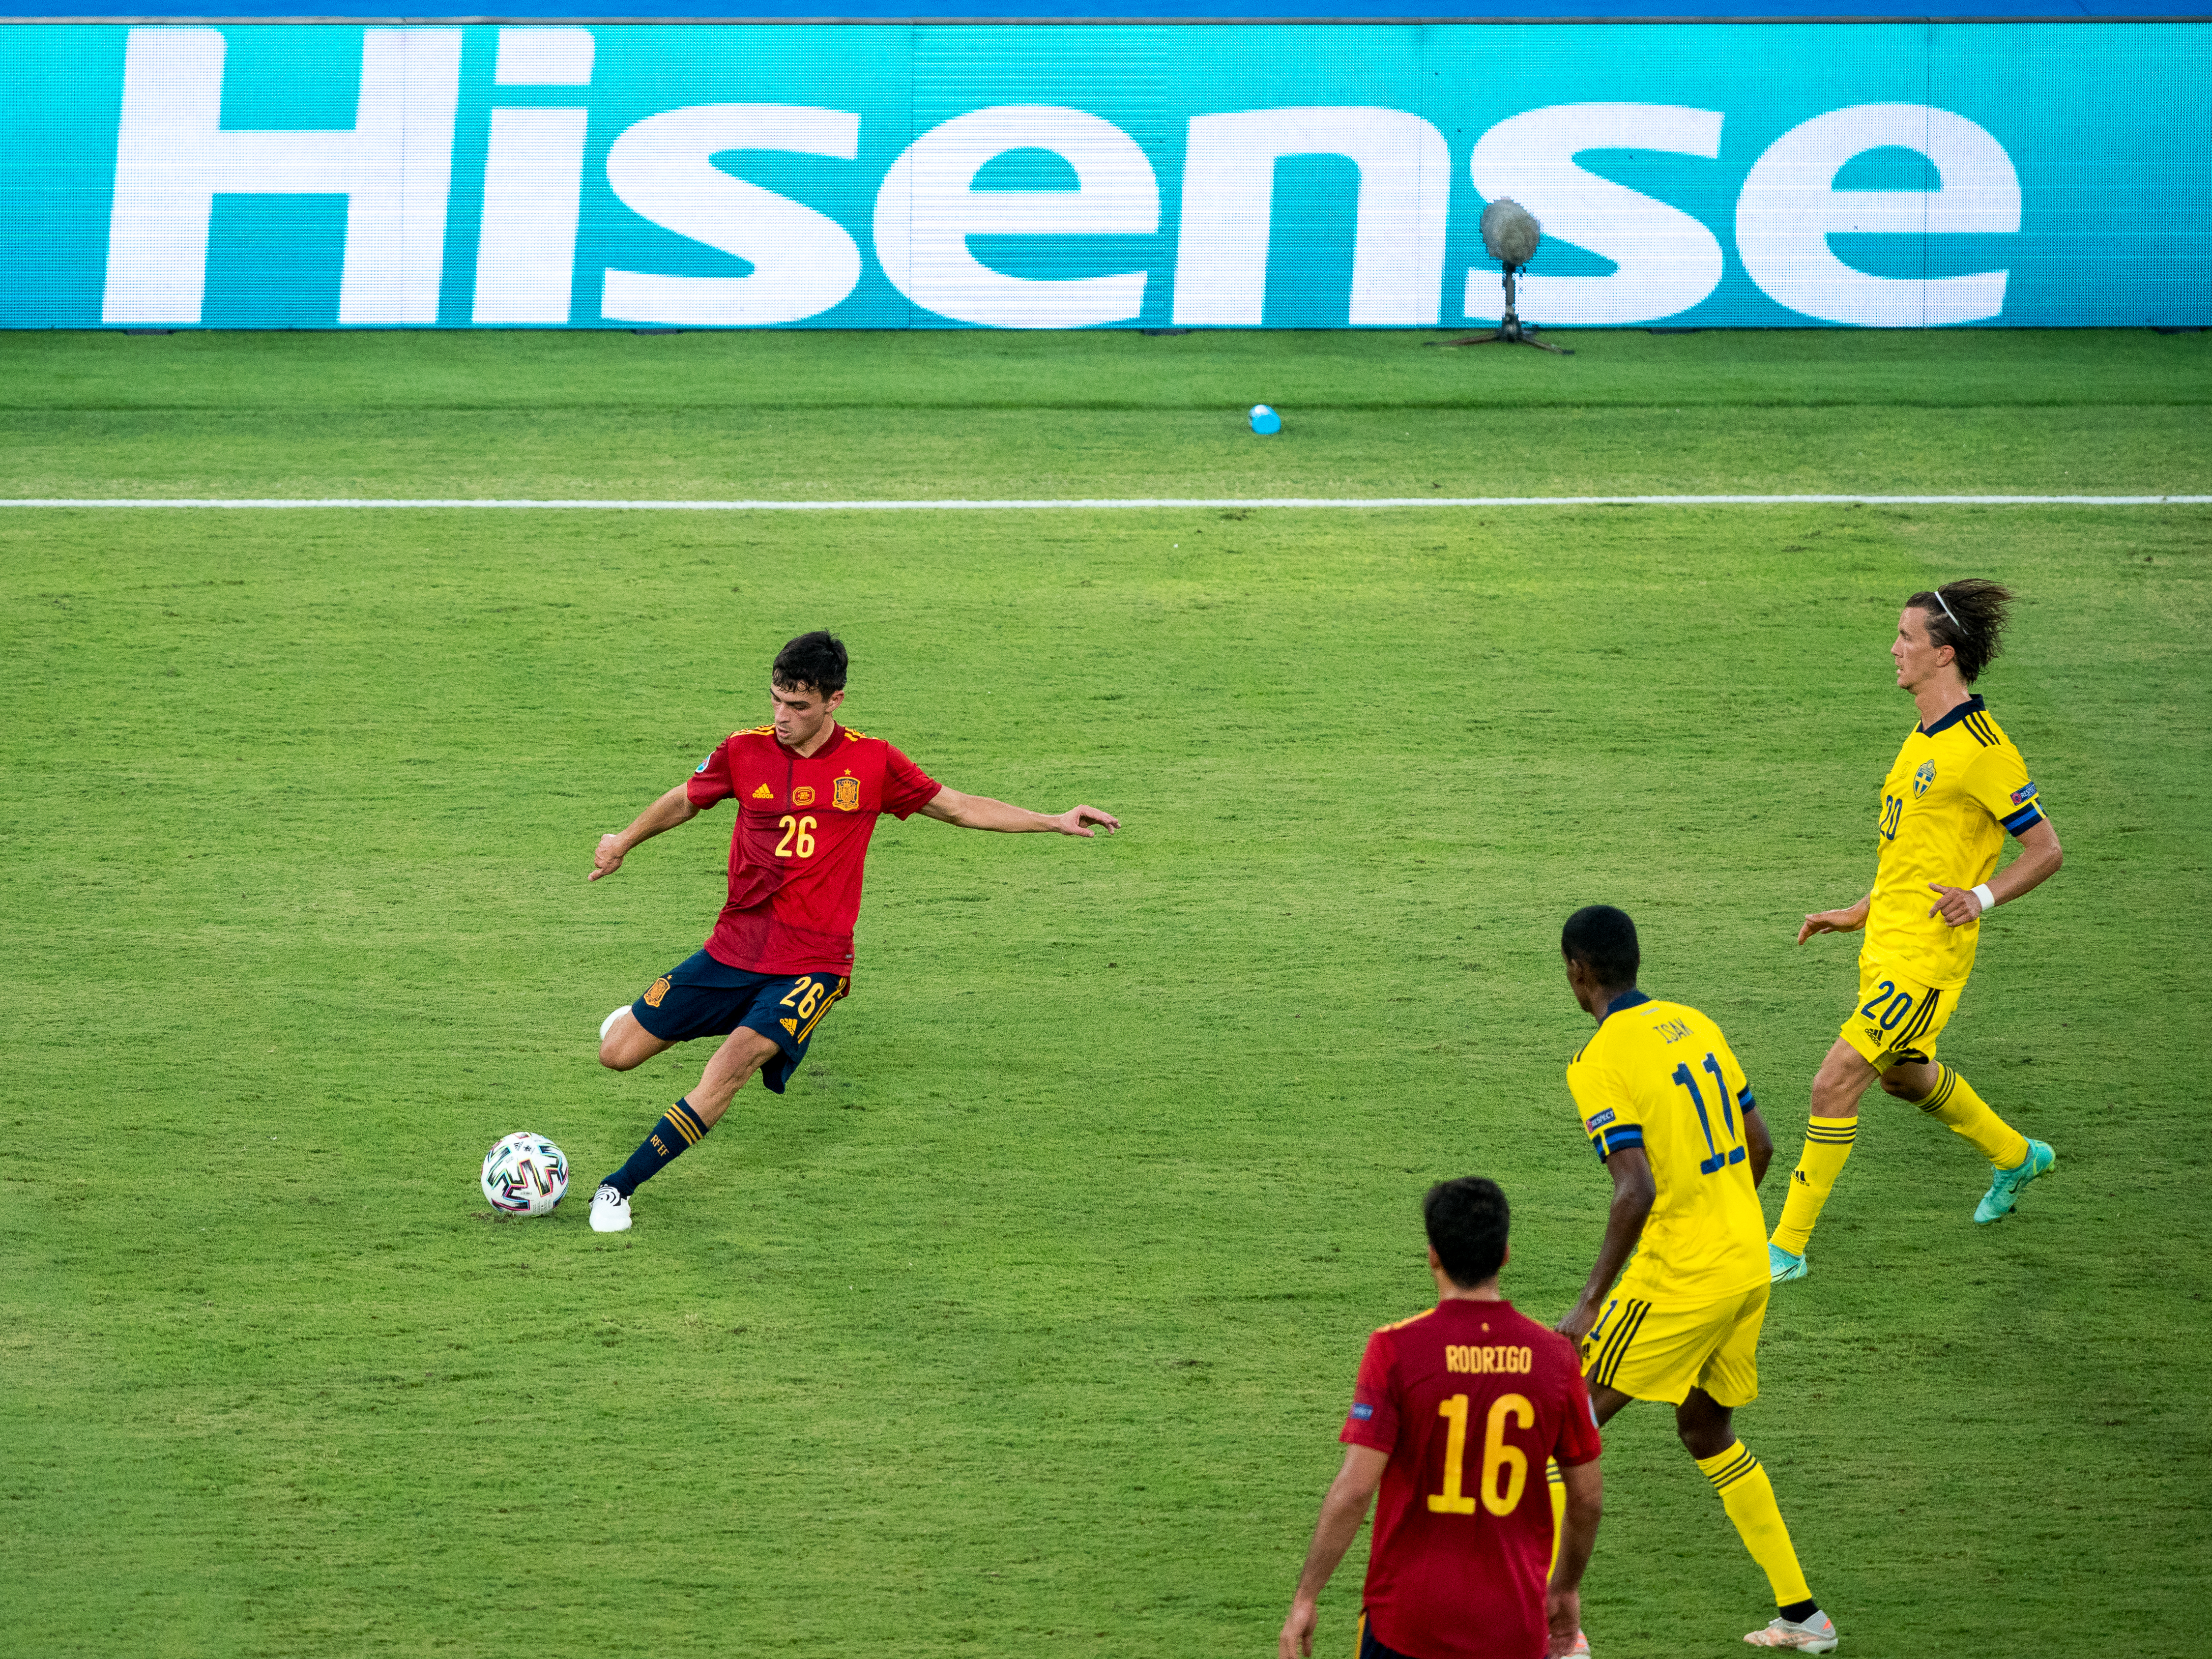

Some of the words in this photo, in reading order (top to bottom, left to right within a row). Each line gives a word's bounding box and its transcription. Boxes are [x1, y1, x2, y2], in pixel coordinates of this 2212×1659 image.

[102, 28, 2021, 328] Hisense
[775, 815, 817, 858] 26
[1879, 794, 1903, 841] 20
[780, 976, 824, 1019] 26
[1861, 980, 1913, 1030] 20
[780, 1019, 795, 1037] adidas
[1653, 1017, 1694, 1045] ISAK
[1864, 1028, 1881, 1047] adidas
[1672, 1051, 1746, 1175] 11
[650, 1134, 669, 1157] RFEF
[1445, 1345, 1533, 1374] RODRIGO
[1427, 1393, 1535, 1517] 16
